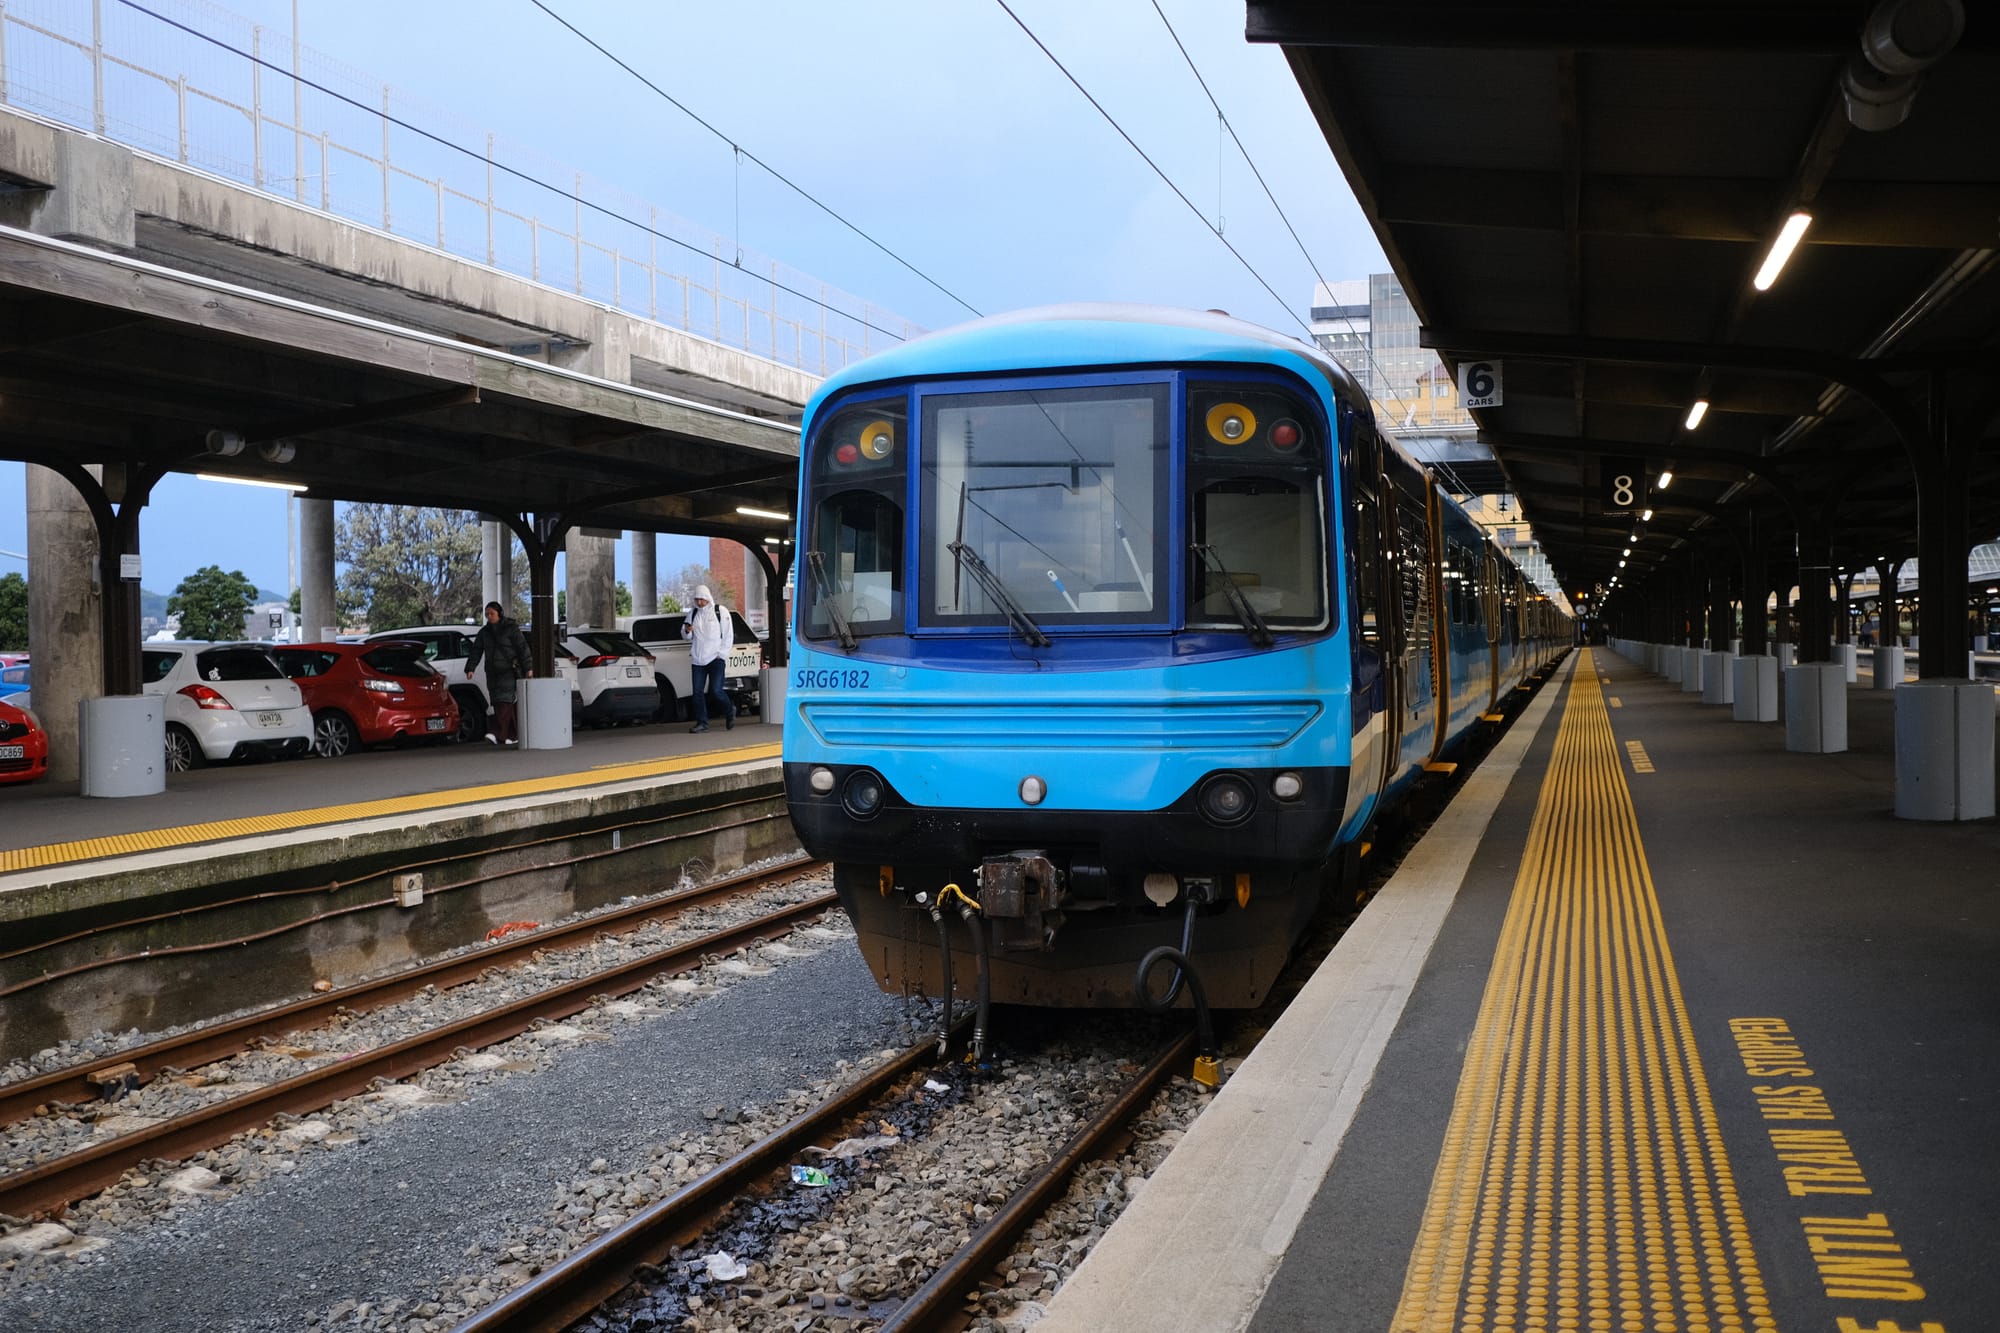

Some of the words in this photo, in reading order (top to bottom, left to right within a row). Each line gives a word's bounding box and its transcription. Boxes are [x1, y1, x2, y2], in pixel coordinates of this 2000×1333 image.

[1466, 362, 1495, 398] 6
[1467, 397, 1494, 406] CARS
[1613, 475, 1634, 506] 8
[1594, 582, 1602, 594] 8
[729, 656, 756, 668] TOYOTA
[796, 669, 870, 689] SRG6182
[1727, 1017, 1815, 1078] STOPPED
[1751, 1085, 1835, 1120] HAS
[1767, 1129, 1873, 1197] TRAIN
[1800, 1213, 1927, 1301] UNTIL
